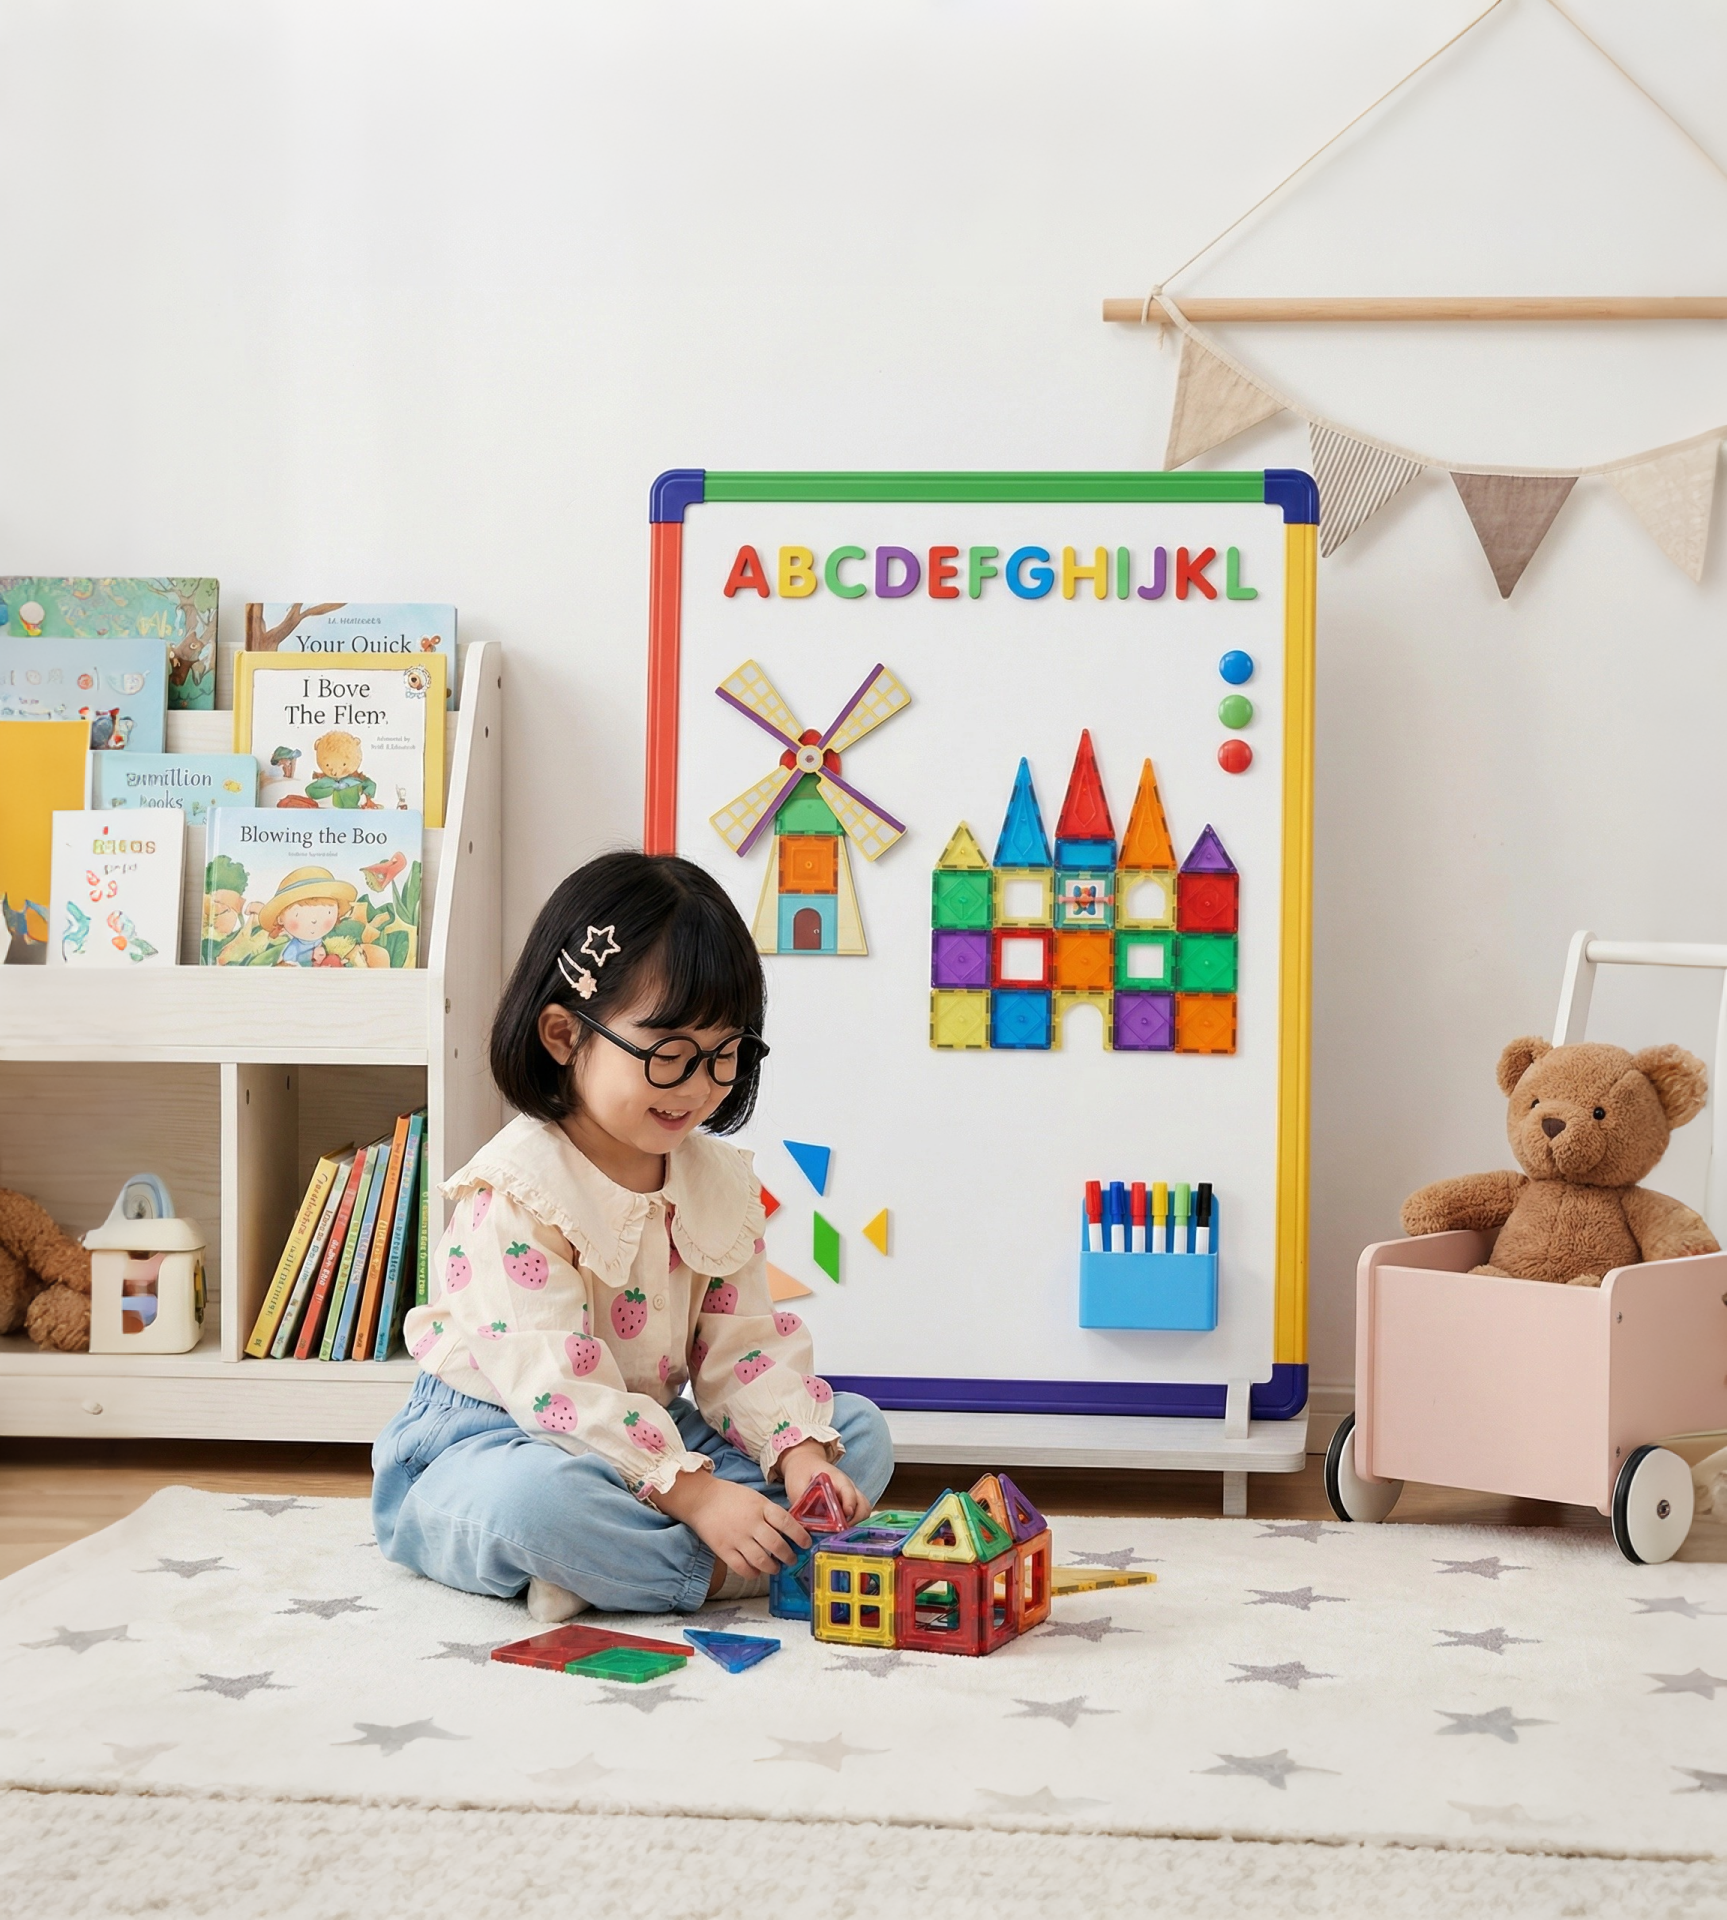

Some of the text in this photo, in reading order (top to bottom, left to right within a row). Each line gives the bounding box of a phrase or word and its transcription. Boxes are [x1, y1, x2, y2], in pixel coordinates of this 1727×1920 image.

[723, 544, 1258, 600] ABCDEFGHIJKL
[296, 635, 345, 653] Your
[302, 678, 371, 698] I Bove
[284, 703, 326, 725] The
[240, 825, 388, 849] Blowing the Boo
